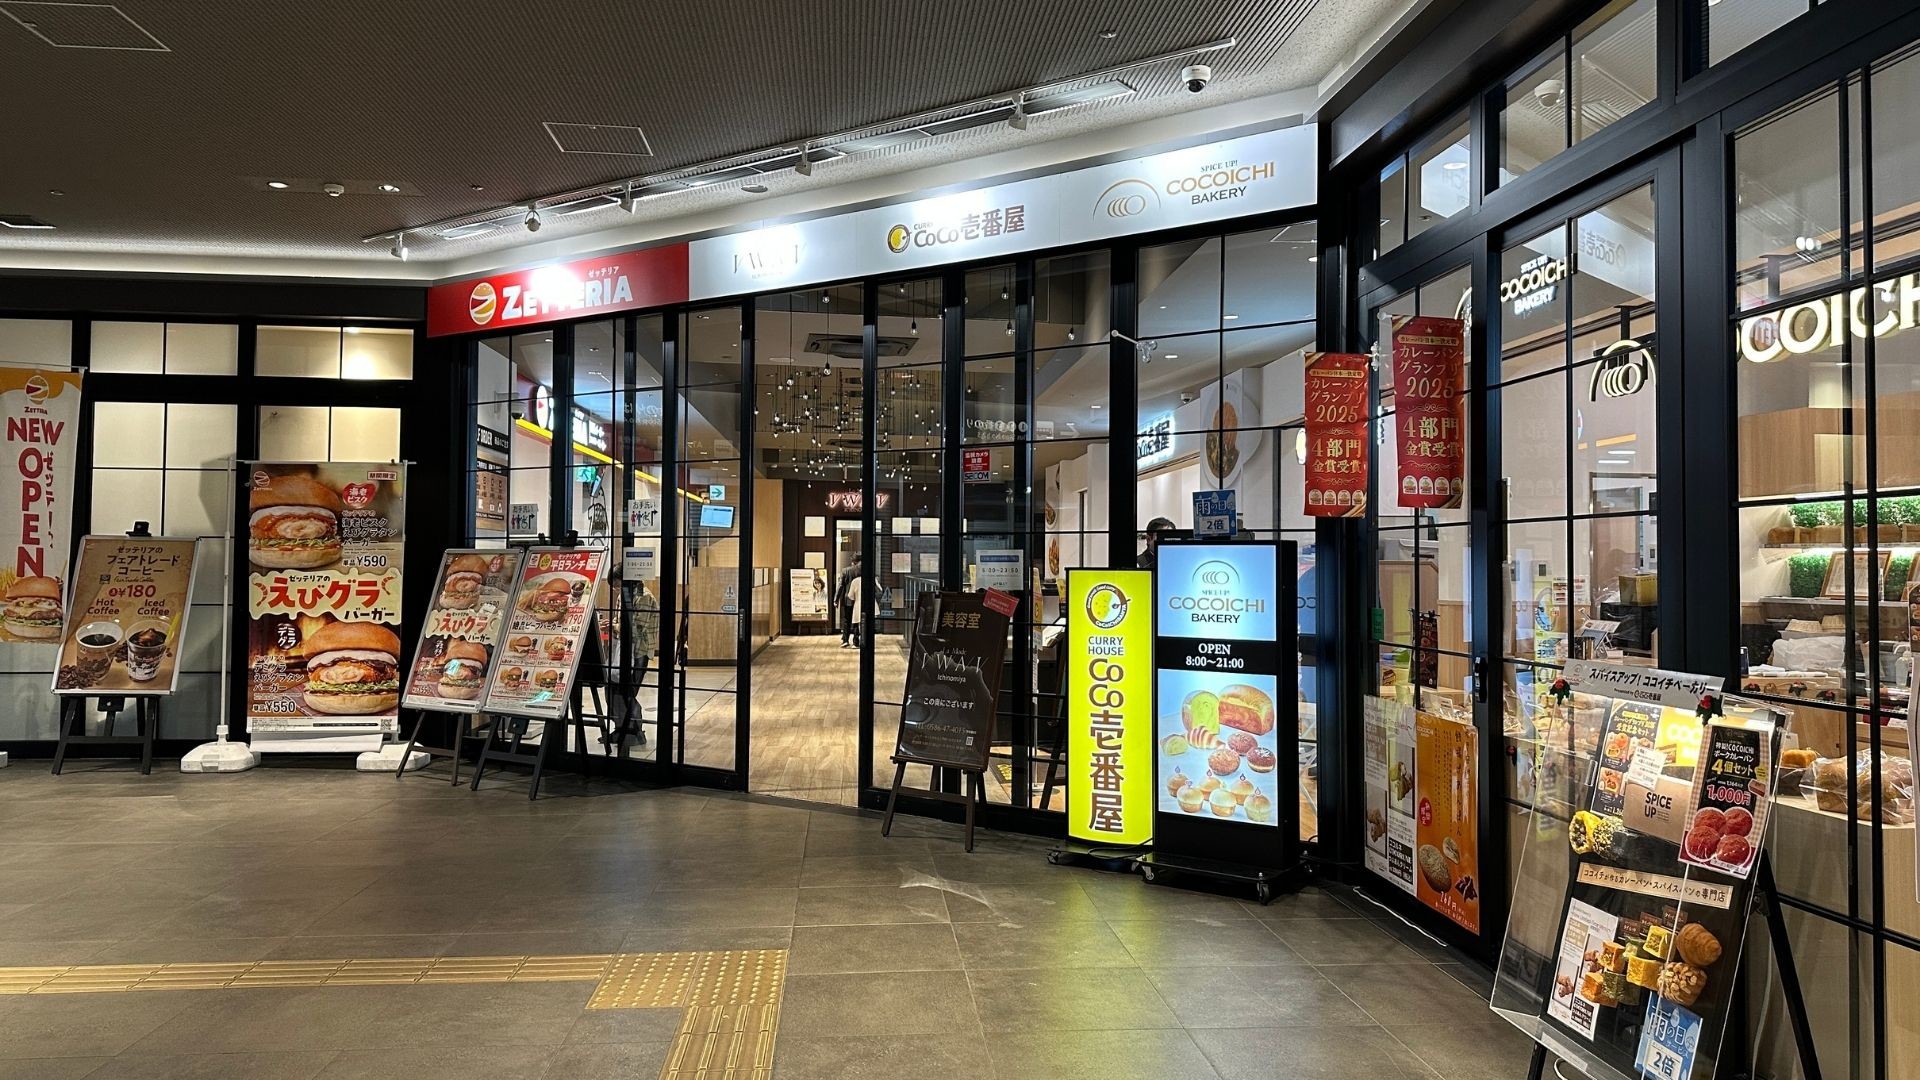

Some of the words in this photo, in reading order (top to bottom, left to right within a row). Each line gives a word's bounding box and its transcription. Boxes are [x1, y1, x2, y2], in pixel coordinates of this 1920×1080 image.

[1201, 163, 1222, 172] SPICE
[1166, 162, 1274, 195] COCOICHI
[1192, 186, 1247, 205] BAKERY
[914, 205, 1024, 247] CoCo壱番屋
[588, 266, 620, 277] ゼッテリア
[1400, 345, 1459, 359] カレーパン
[1400, 360, 1459, 375] グランプリ
[1311, 378, 1363, 389] カレーパン
[1405, 377, 1455, 398] 2025
[1311, 391, 1365, 404] グランプリ
[1315, 405, 1358, 423] 2025
[7, 417, 65, 446] NEW
[1403, 416, 1459, 439] 4部門
[1311, 438, 1361, 458] 4部門
[1404, 441, 1460, 457] 金賞受賞
[1312, 459, 1362, 473] 金賞受賞
[964, 471, 989, 480] SECOM
[17, 447, 44, 578] OPEN
[1206, 519, 1224, 530] 2倍
[107, 554, 180, 566] フェアトレード
[357, 556, 387, 567] ¥590
[550, 559, 586, 571] 平日ランチ
[118, 566, 165, 575] コーヒー
[268, 577, 380, 610] えびグラ
[87, 606, 120, 615] Coffee
[1169, 596, 1265, 613] COCOICHI
[137, 607, 170, 616] Coffee
[344, 607, 395, 621] バーガー
[440, 612, 488, 634] えびグラ
[942, 612, 981, 629] 美容室
[1191, 613, 1240, 624] BAKERY
[278, 626, 295, 636] デミ
[278, 637, 296, 646] グラ
[1088, 636, 1123, 645] CURRY
[1088, 647, 1124, 656] HOUSE
[1198, 643, 1231, 655] OPEN
[254, 664, 287, 672] デミグラ
[1185, 656, 1244, 668] 8:00〜21:00
[254, 674, 304, 682] えびグラタン
[1589, 668, 1642, 687] スパイスアップ!
[1643, 676, 1714, 694] ココイチベーカリー
[253, 683, 288, 692] バーガー
[266, 701, 296, 712] ¥550
[923, 698, 974, 709] この奥にございます
[1714, 750, 1754, 763] ポークカレーパン
[1712, 759, 1753, 776] 4個セット
[1646, 791, 1672, 809] SPICE
[1707, 784, 1751, 805] 1,000円
[1644, 805, 1656, 818] UP
[1647, 1005, 1686, 1046] 雨の日
[1653, 1051, 1675, 1077] 2倍
